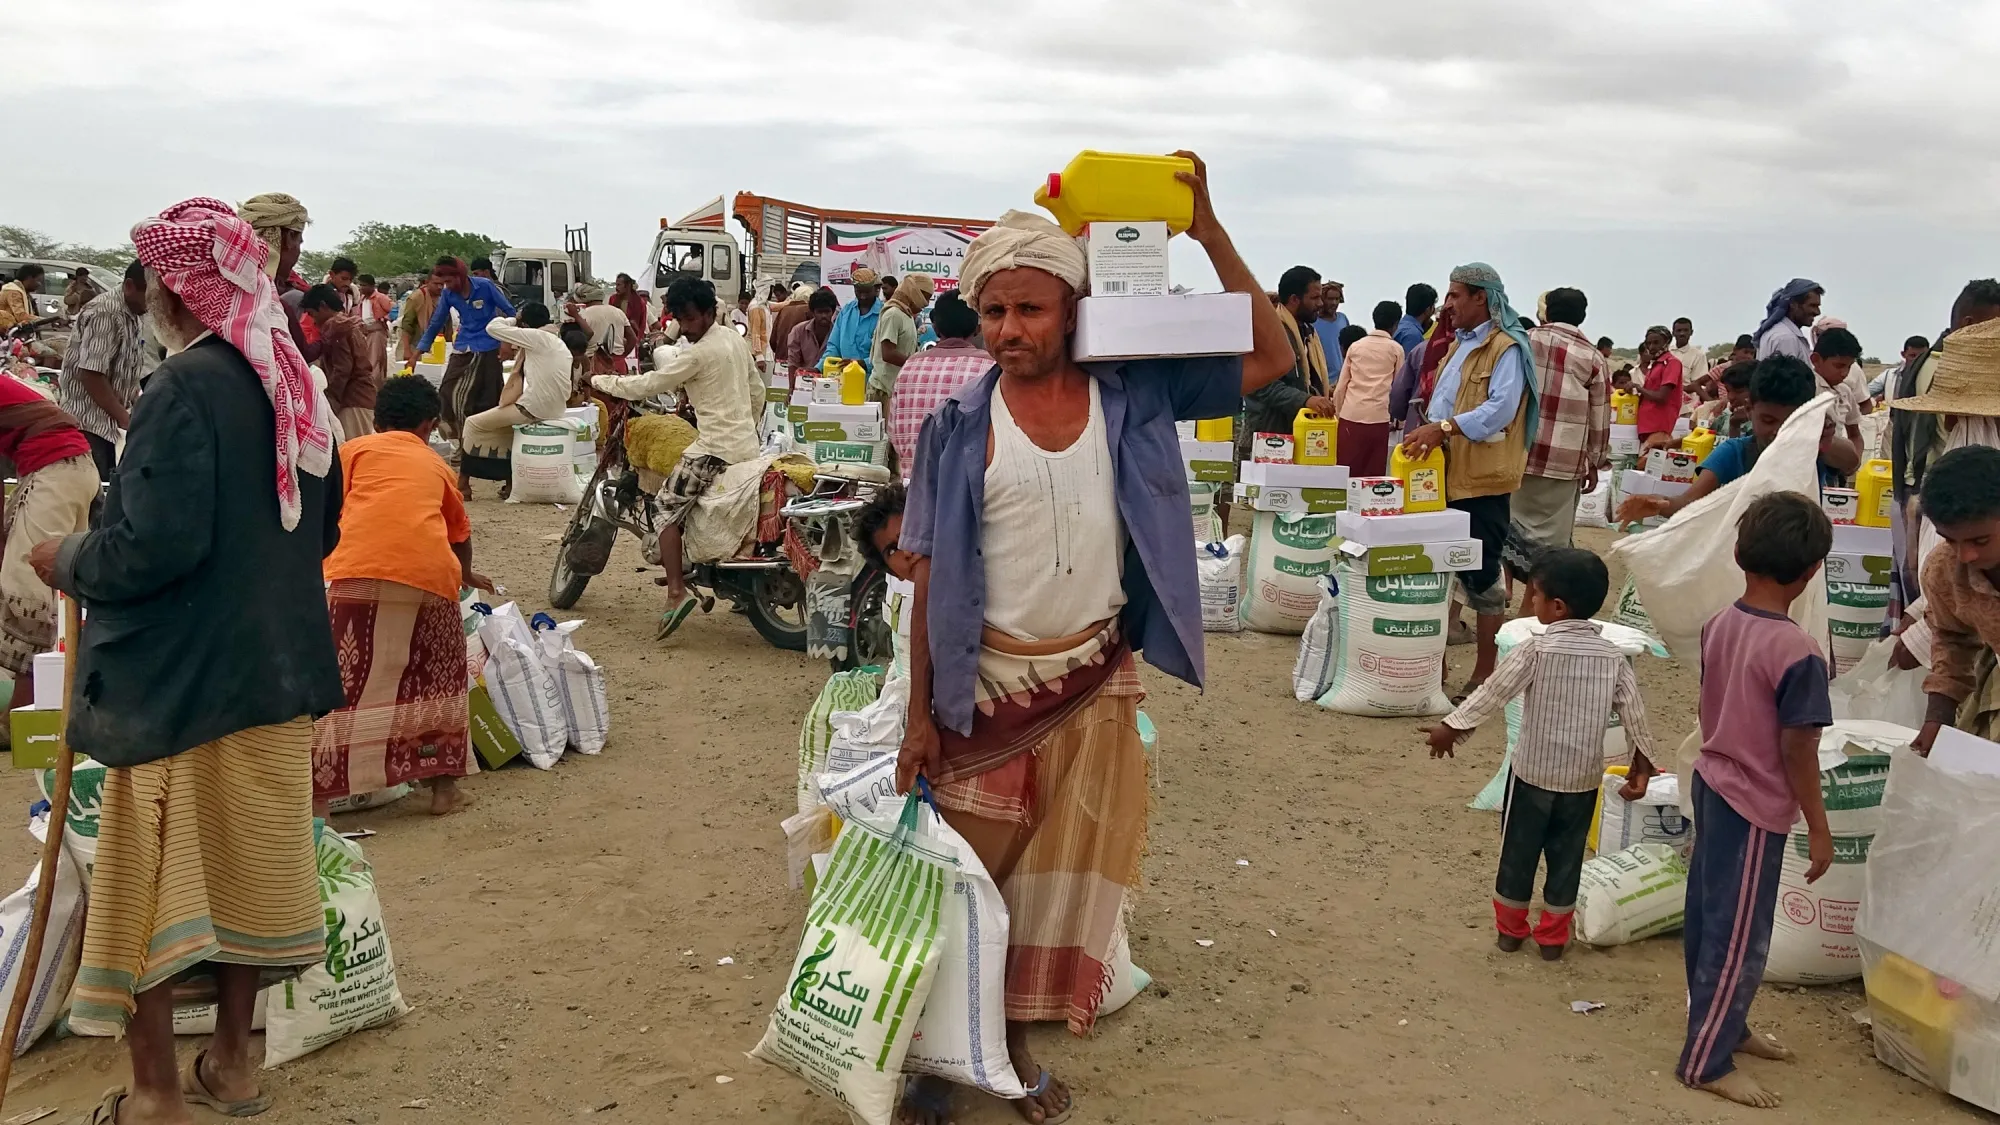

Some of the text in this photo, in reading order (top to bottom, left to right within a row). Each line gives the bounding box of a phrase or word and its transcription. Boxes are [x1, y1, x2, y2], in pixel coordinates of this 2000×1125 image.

[899, 245, 953, 257] شاحنات
[900, 260, 950, 278] والعطاء
[820, 446, 868, 462] السنابل
[1280, 520, 1335, 541] السنابل
[1282, 562, 1304, 574] أبيض
[1375, 572, 1445, 597] السنابل
[1384, 622, 1434, 636] دقيق أبيض
[1832, 624, 1859, 634] أبيض
[839, 750, 852, 758] 2018
[1838, 783, 1886, 798] ALSANAB
[1790, 908, 1802, 918] 50
[1824, 912, 1849, 922] Fortified
[352, 916, 382, 951] سكر
[362, 968, 386, 990] أبيض
[818, 970, 870, 1003] سكر
[309, 987, 337, 1003] ونقي
[338, 979, 361, 997] ناعم
[318, 1000, 340, 1012] PURE
[340, 994, 356, 1006] FINE
[357, 988, 378, 1002] WHITE
[384, 1006, 396, 1021] 10
[787, 1018, 810, 1034] ناعم
[807, 1011, 855, 1039] ALSAEED SUGAR
[810, 1031, 841, 1052] أبيض
[786, 1030, 802, 1046] FINE
[802, 1039, 825, 1059] WHITE
[825, 1052, 853, 1072] SUGAR
[840, 1046, 866, 1061] سكر
[832, 1086, 847, 1104] 10
